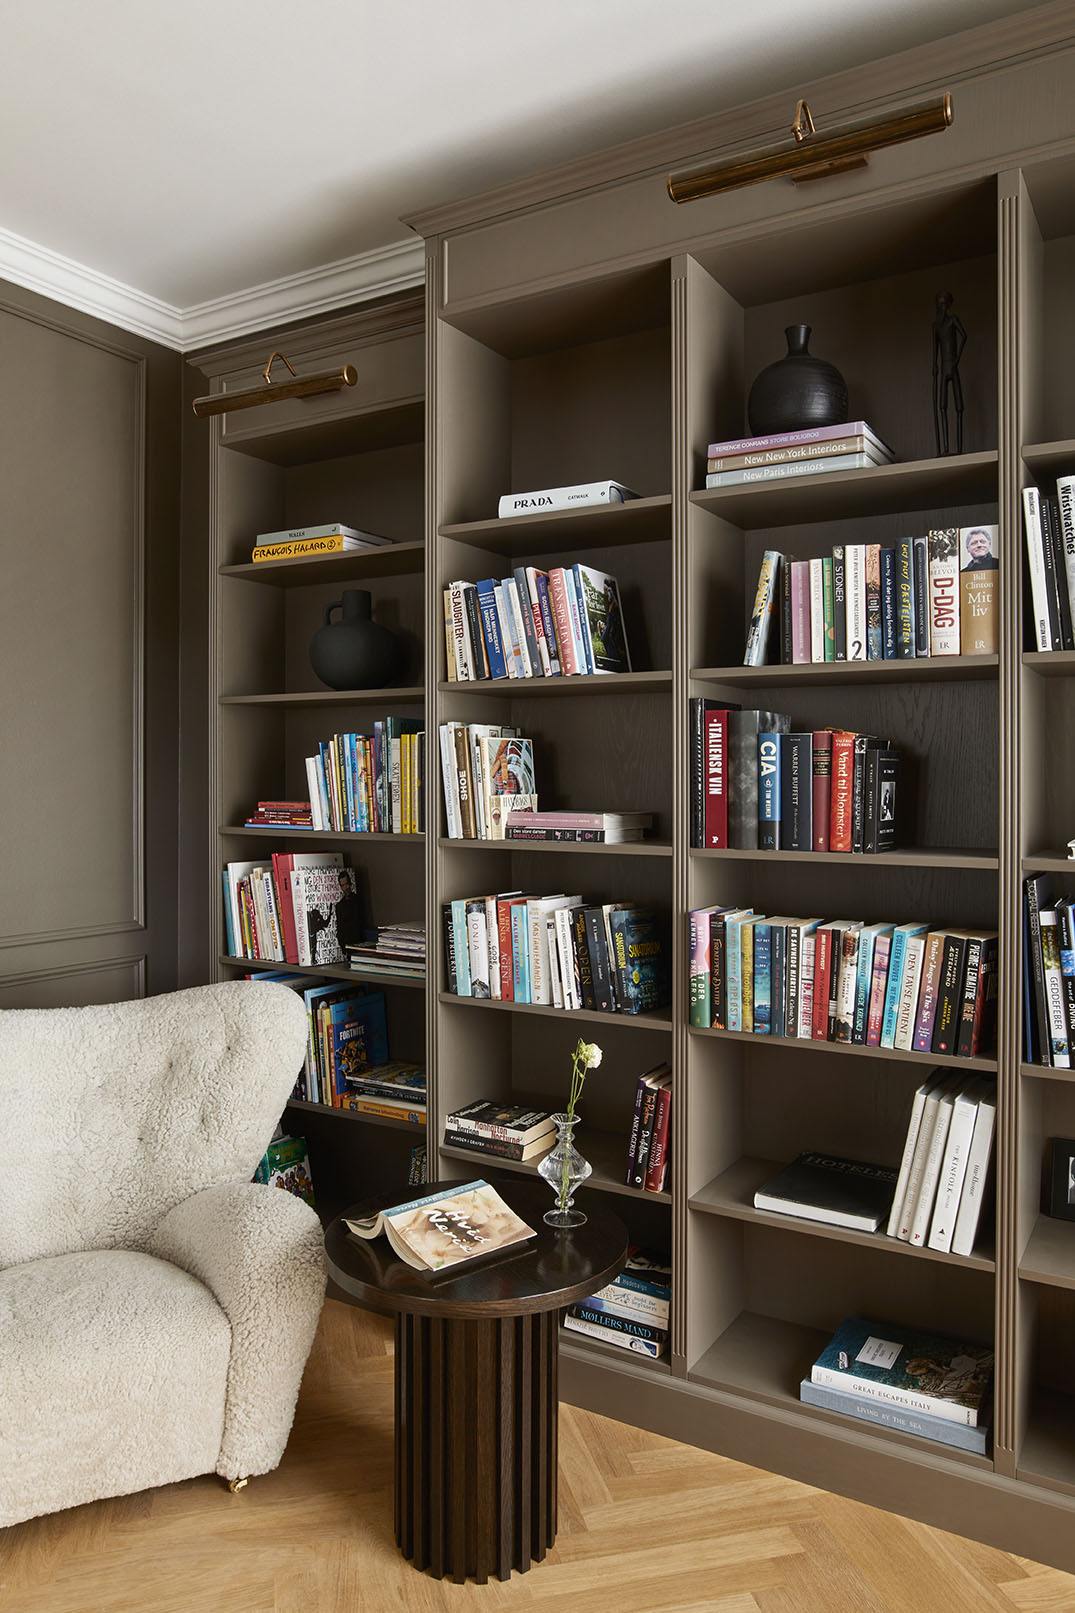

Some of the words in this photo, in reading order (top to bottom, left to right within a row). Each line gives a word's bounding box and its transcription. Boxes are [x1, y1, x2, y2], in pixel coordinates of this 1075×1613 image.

[744, 454, 763, 466] New
[766, 451, 785, 462] New
[788, 447, 806, 459] York
[808, 442, 847, 455] Interiors
[743, 470, 763, 481] New
[765, 467, 784, 478] Paris
[787, 461, 824, 475] Interiors
[513, 496, 553, 509] PRADA
[568, 493, 589, 501] CATWALK
[1060, 484, 1075, 555] Wristwatches
[253, 545, 293, 559] FRANÇOIS
[293, 541, 327, 554] HALARD
[901, 543, 909, 558] LUCY
[901, 560, 909, 580] FOLEY
[835, 566, 844, 602] STONER
[965, 581, 993, 589] Clinton
[541, 595, 549, 616] SOUTH
[933, 577, 955, 628] D-DAG
[968, 592, 993, 604] Mit
[451, 590, 464, 639] SLAUGHTER
[532, 603, 544, 638] PILATES
[900, 583, 911, 643] GÆSTELISTEN
[972, 605, 987, 617] liv
[544, 616, 552, 637] BEACH
[851, 640, 862, 661] 2
[709, 723, 722, 774] ITALIENSK
[761, 741, 777, 776] CIA
[838, 751, 849, 776] Vand
[392, 762, 400, 803] SKATTEØEN
[459, 770, 468, 800] SHOE
[709, 777, 722, 795] VIN
[838, 779, 849, 789] til
[836, 792, 847, 838] blomster
[264, 878, 273, 913] SEBASTIANS
[791, 929, 797, 938] DE
[533, 922, 541, 990] KASTANJEMANDEN
[615, 932, 626, 969] SANATORIUM
[894, 935, 903, 959] COLLEEN
[928, 939, 939, 962] Daisy
[968, 944, 980, 967] PIERRE
[501, 950, 509, 988] AGENT
[578, 946, 591, 985] OPEN
[891, 960, 900, 981] HOOVER
[908, 953, 916, 971] DEN
[927, 961, 937, 984] Jones
[904, 975, 914, 998] TAVSE
[965, 967, 977, 1000] LEMAITRE
[923, 994, 933, 1009] The
[963, 1002, 976, 1023] IRÈNE
[1050, 976, 1063, 1030] GEDDEFEBER
[900, 1002, 911, 1035] PATIENT
[921, 1010, 931, 1023] Six
[629, 1114, 640, 1158] ANKLAGEREN
[653, 1143, 663, 1167] HENNA
[946, 1155, 959, 1193] KINFOLK
[580, 1310, 622, 1330] MØLLERS
[623, 1323, 651, 1338] MAND
[853, 1384, 876, 1395] GREAT
[878, 1390, 909, 1404] ESCAPES
[911, 1398, 932, 1411] ITALY
[856, 1405, 879, 1417] LIVING
[881, 1412, 891, 1421] BY
[893, 1415, 907, 1426] THE
[909, 1420, 923, 1431] SEA
